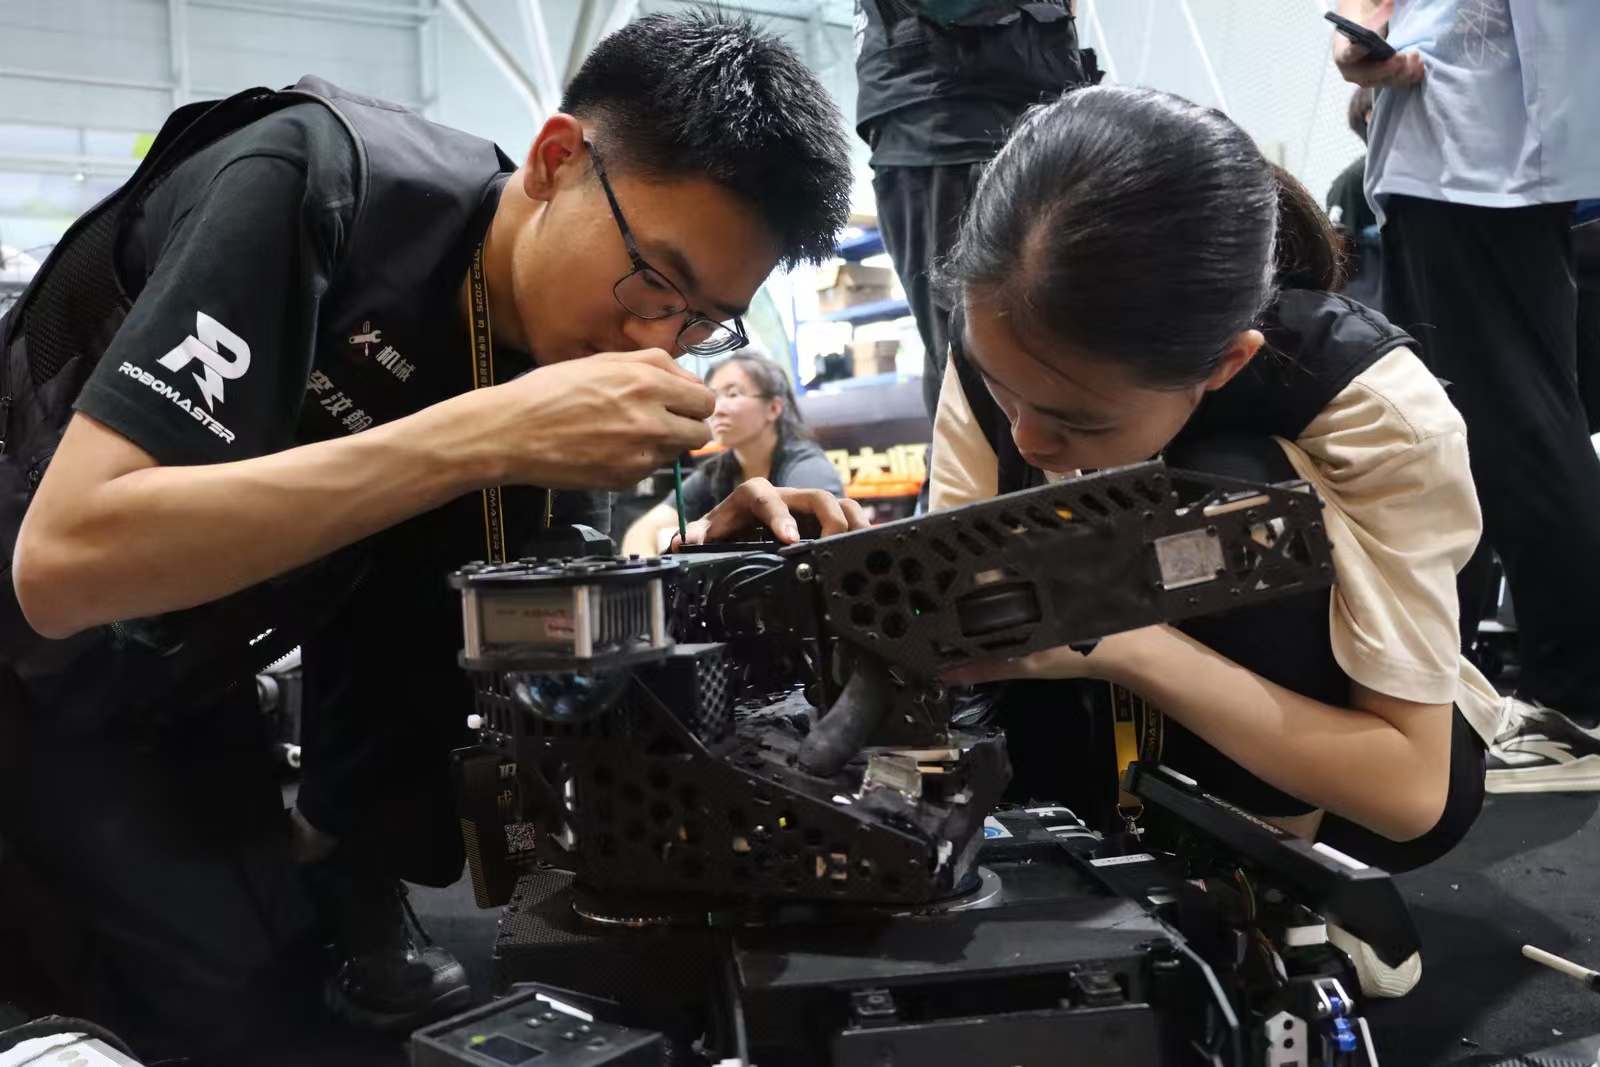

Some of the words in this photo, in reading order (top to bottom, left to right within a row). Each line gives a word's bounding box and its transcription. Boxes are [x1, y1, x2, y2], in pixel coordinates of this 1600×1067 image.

[474, 282, 484, 312] 2025
[375, 345, 417, 383] 机械
[118, 361, 236, 444] ROBOMASTER
